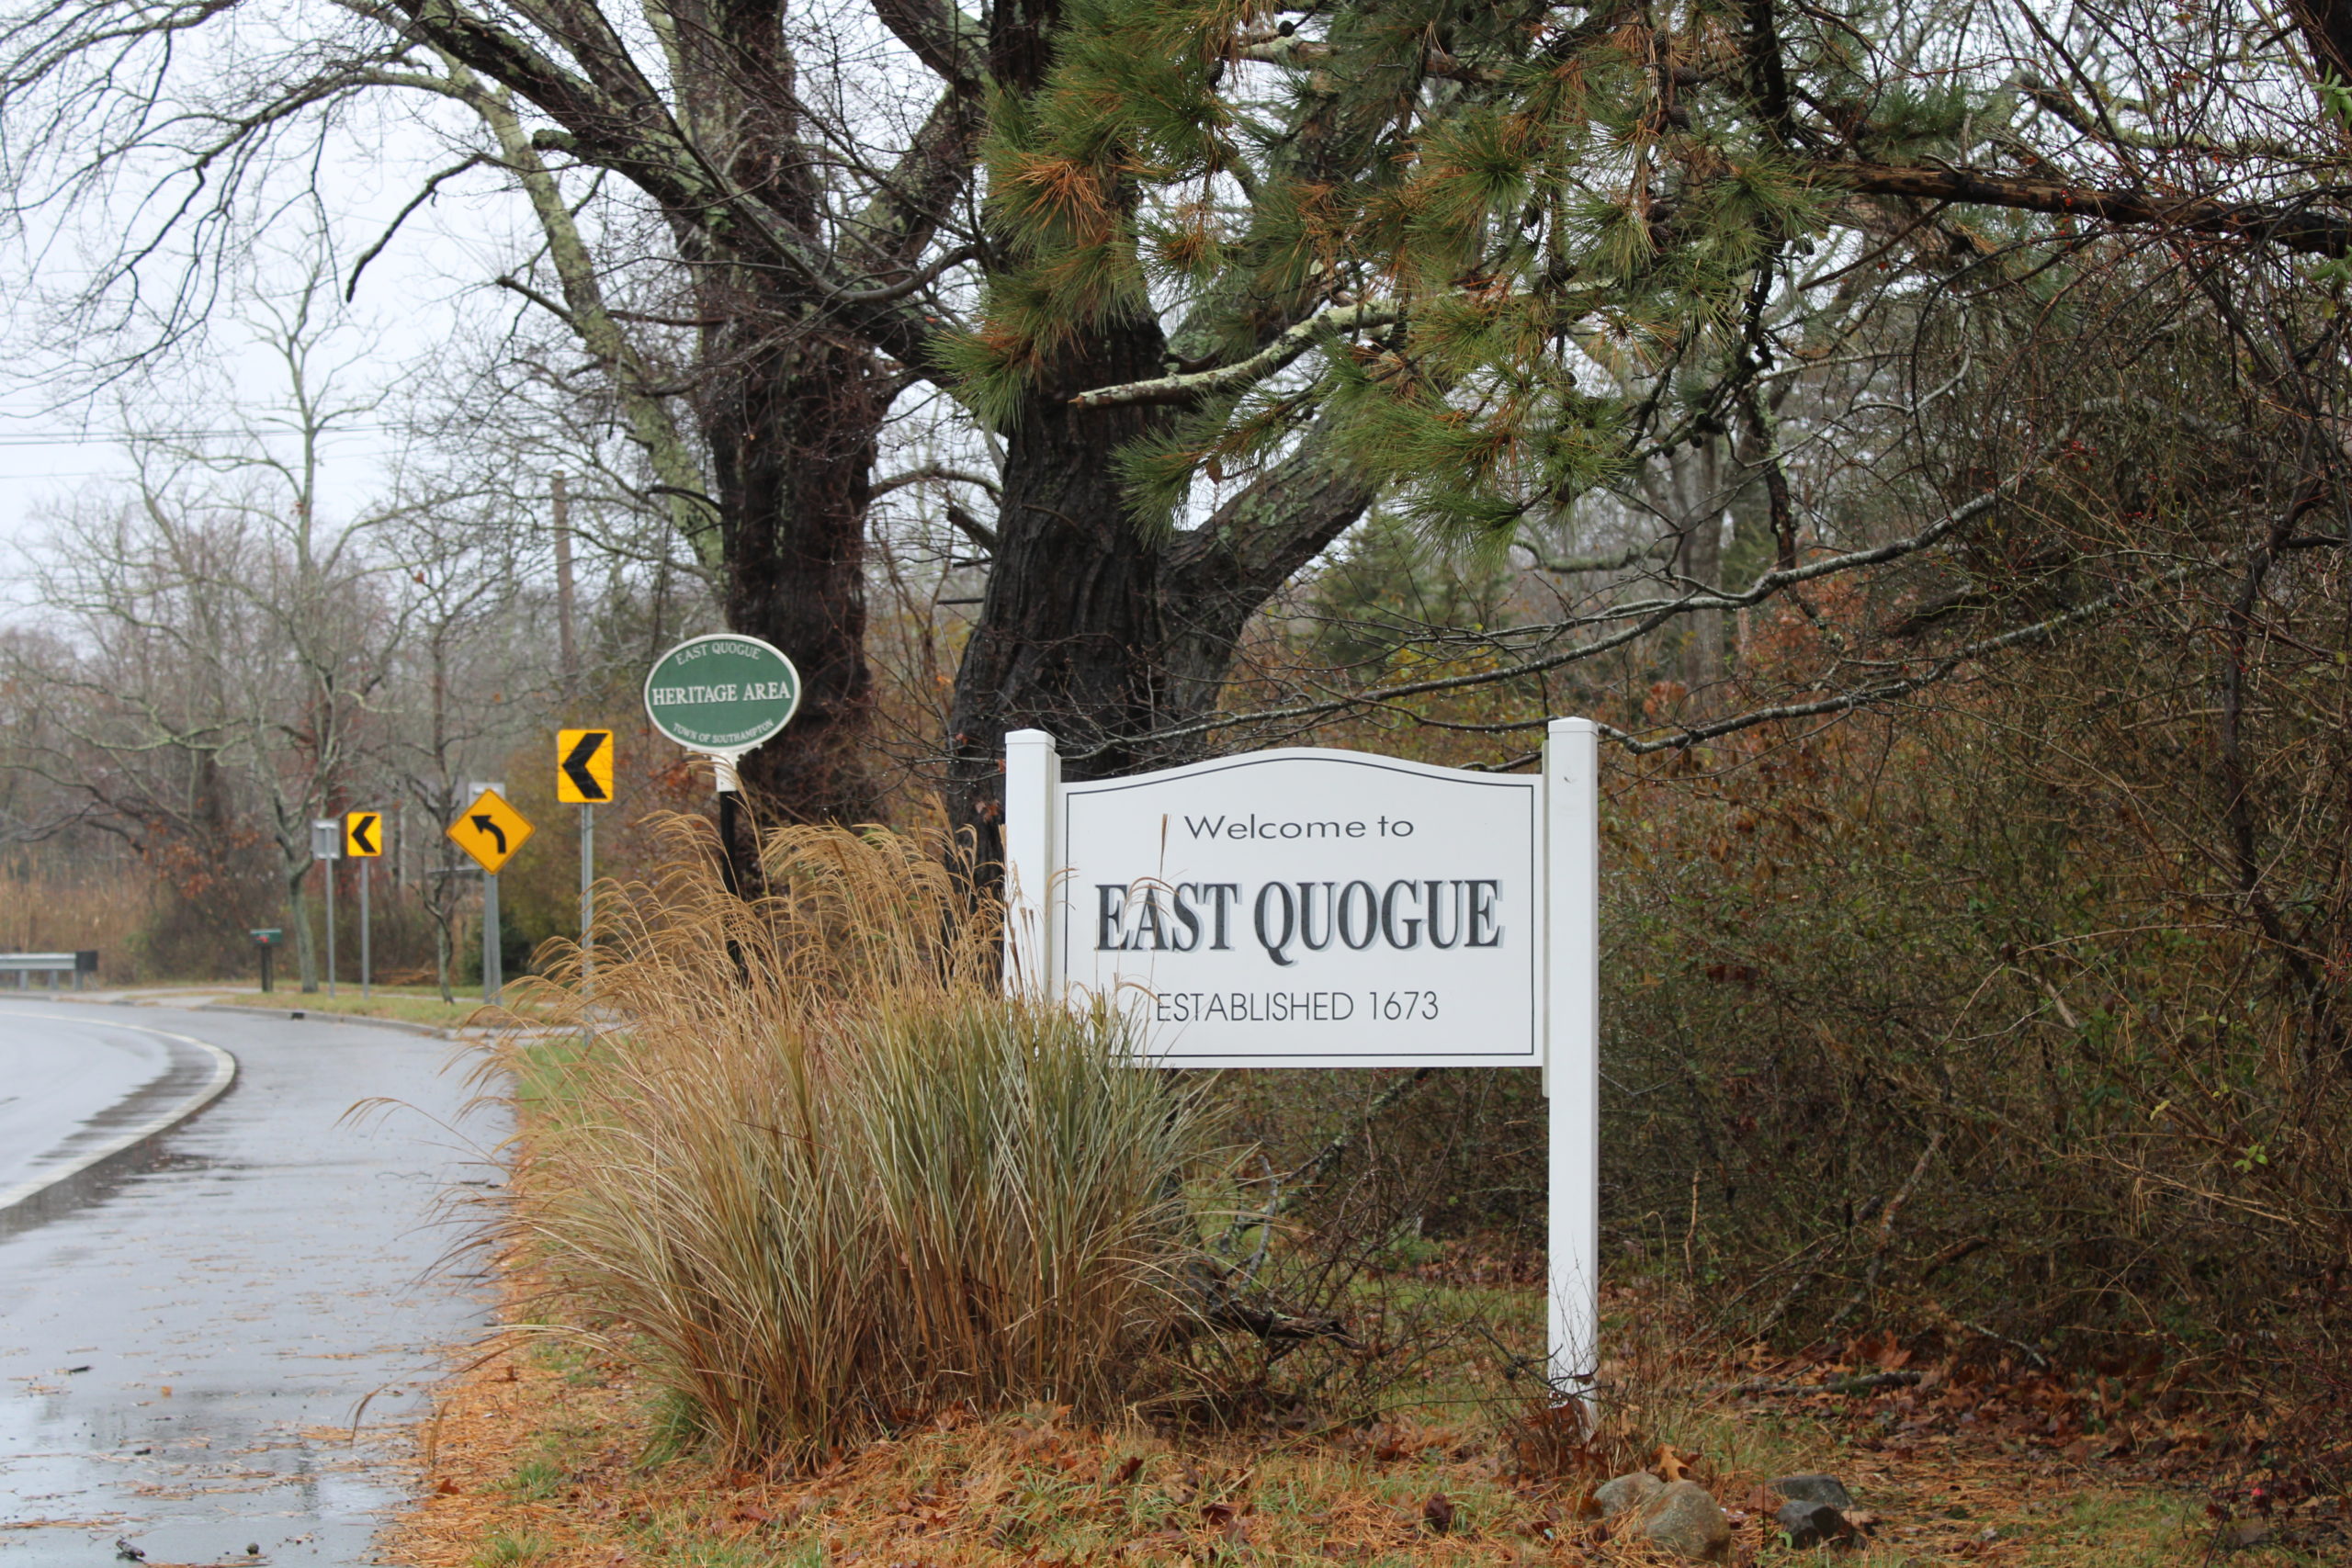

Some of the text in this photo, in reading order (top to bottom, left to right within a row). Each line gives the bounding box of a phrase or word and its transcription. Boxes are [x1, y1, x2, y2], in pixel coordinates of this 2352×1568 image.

[675, 642, 761, 665] EAST QUOGUE
[651, 681, 791, 705] HERITAGE AREA
[673, 718, 774, 743] TOWN OF SOUTHAMPTON
[1184, 814, 1414, 839] Welcome to
[1094, 879, 1505, 966] EAST QUOGUE
[1157, 991, 1439, 1021] ESTABLISHED 1673
